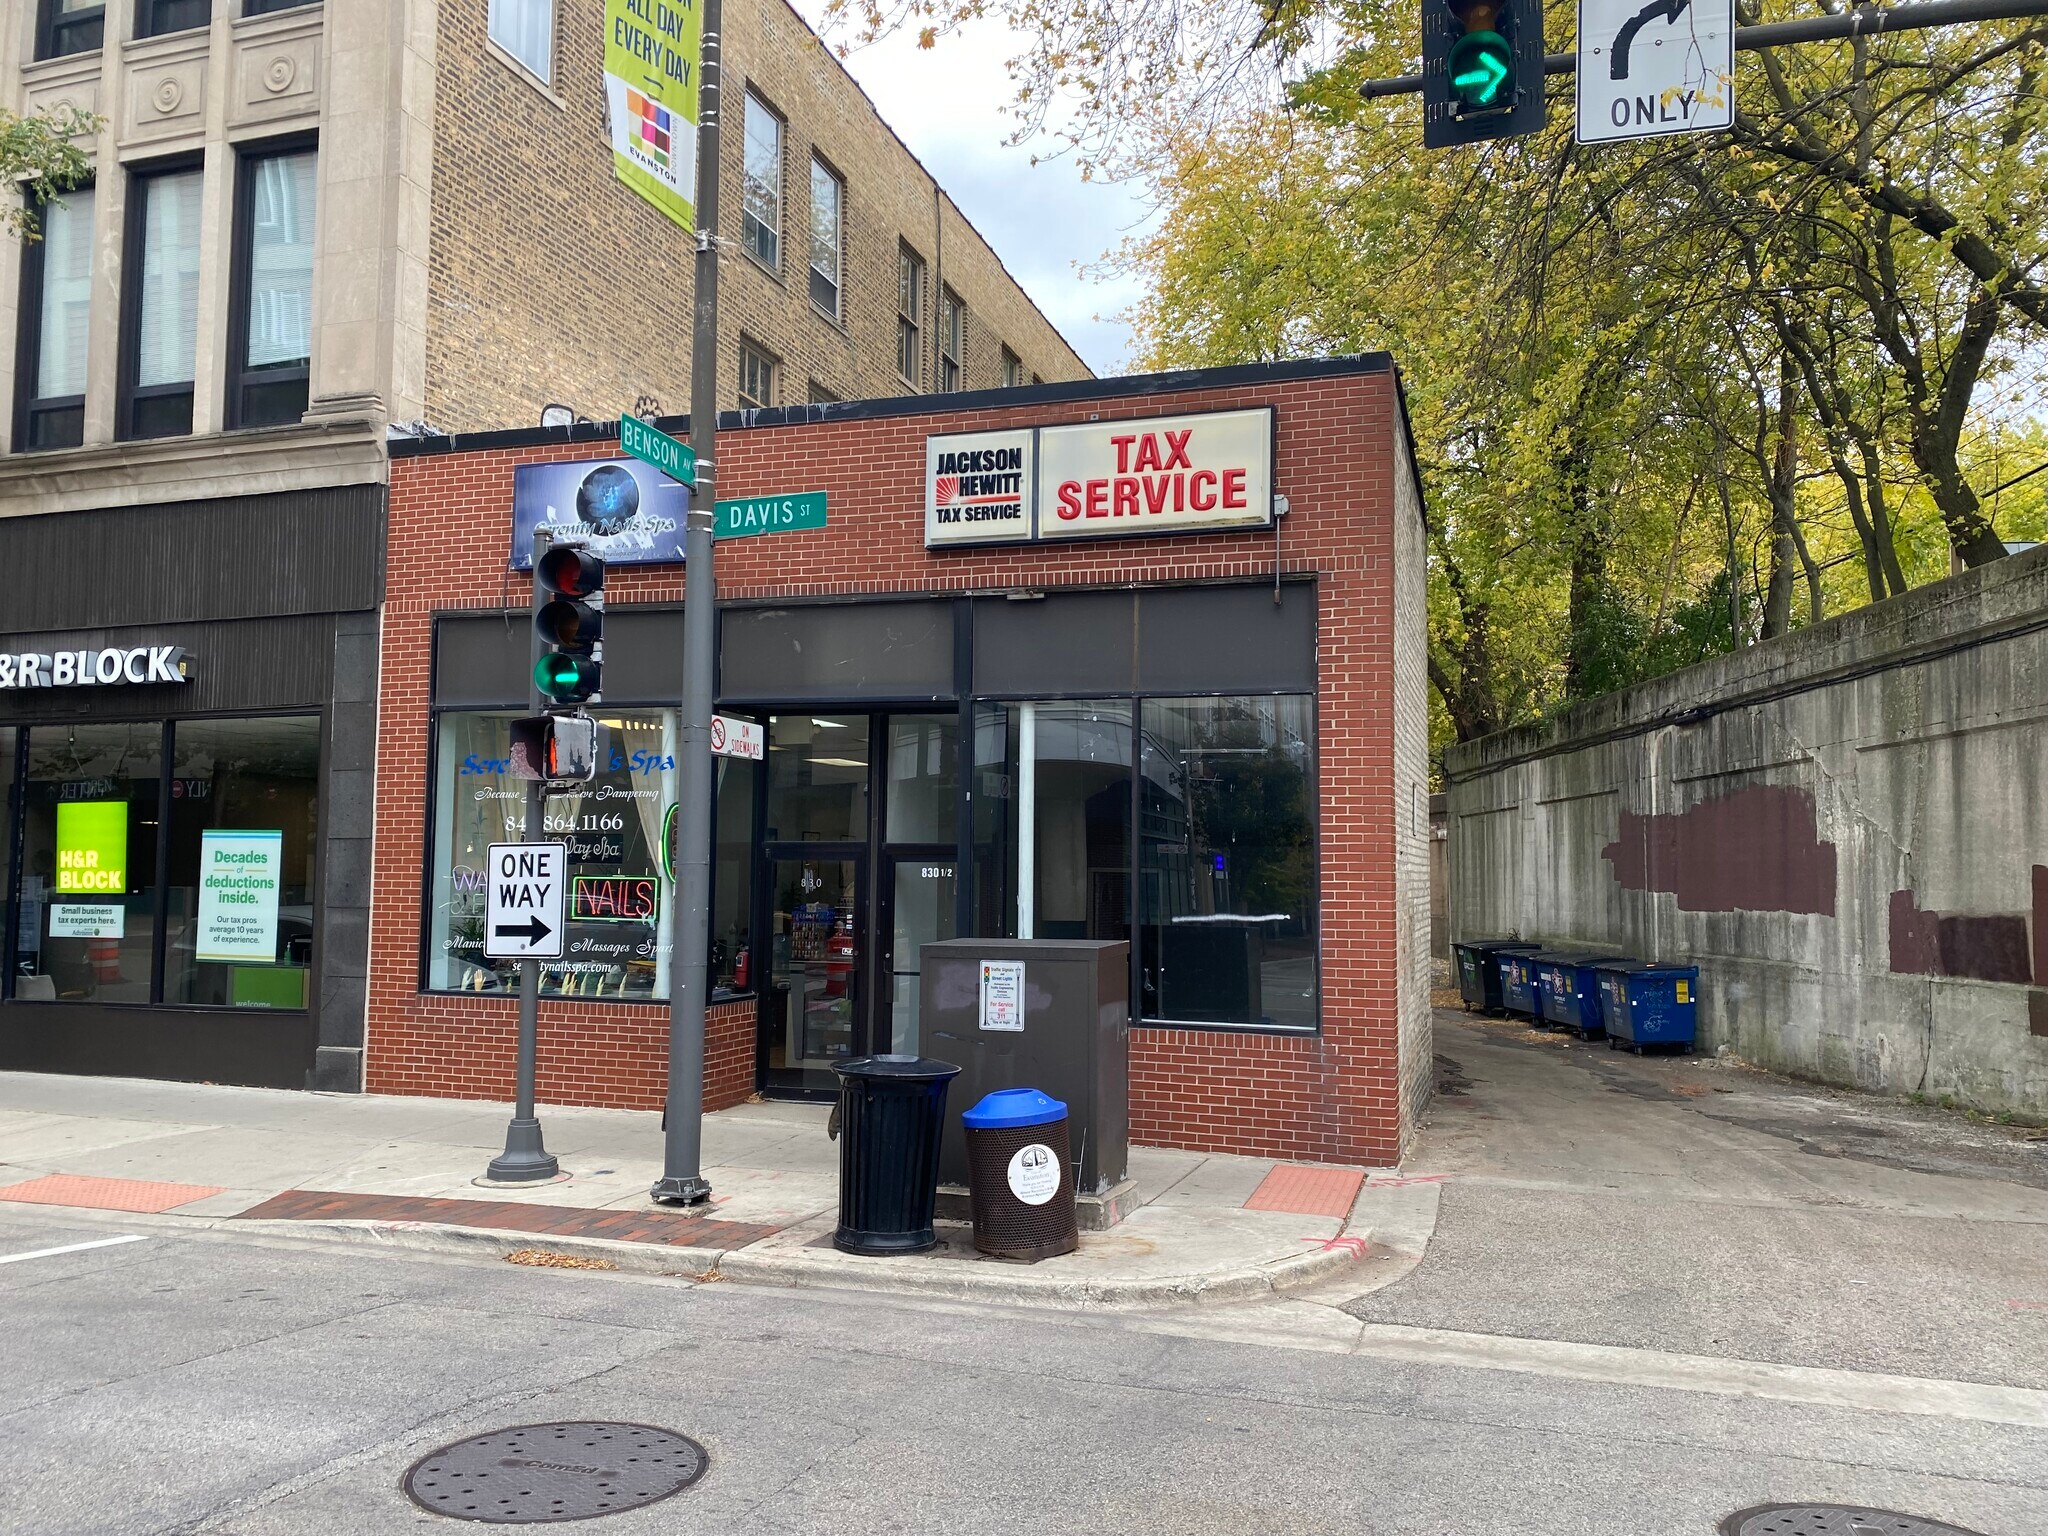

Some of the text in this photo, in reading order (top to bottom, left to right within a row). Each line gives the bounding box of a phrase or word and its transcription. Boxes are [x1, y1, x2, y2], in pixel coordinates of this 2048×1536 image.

[657, 2, 684, 43] DAY
[615, 16, 691, 88] EVERY DAY
[1611, 90, 1695, 127] ONLY
[671, 117, 679, 175] DOWNTOWN
[629, 146, 677, 185] EVANSTON
[624, 421, 691, 471] BENSON AV
[1110, 429, 1193, 474] TAX
[936, 447, 1022, 475] JACKSON
[958, 472, 1022, 497] HEWITT
[1056, 468, 1247, 520] SERVICE
[730, 500, 811, 529] DAVIS ST
[936, 504, 1021, 524] TAX SERVICE
[599, 516, 641, 535] Nails
[644, 515, 676, 537] Spa
[53, 646, 178, 687] BLOCK
[742, 725, 750, 738] ON
[731, 739, 760, 756] SIDEWALKS
[628, 749, 675, 776] Spa
[474, 786, 519, 801] Because
[596, 785, 659, 802] Pampering
[214, 850, 268, 864] Decades
[564, 834, 619, 861] Day Spa
[60, 850, 99, 869] H&R
[236, 866, 244, 874] of
[501, 853, 551, 878] ONE
[60, 870, 122, 889] BLOCK
[205, 874, 275, 889] deductions
[921, 867, 953, 878] 830 1/2
[218, 890, 259, 904] inside.
[499, 883, 552, 909] WAY
[577, 879, 653, 917] NAILS
[58, 916, 116, 925] tax experts here.
[61, 906, 112, 915] Small business
[216, 915, 257, 925] Our tax pros
[209, 926, 264, 935] average 10 years
[213, 935, 260, 944] of experience.
[570, 937, 630, 959] Massages
[235, 1000, 271, 1008] welcome
[524, 1459, 599, 1475] ComEd
